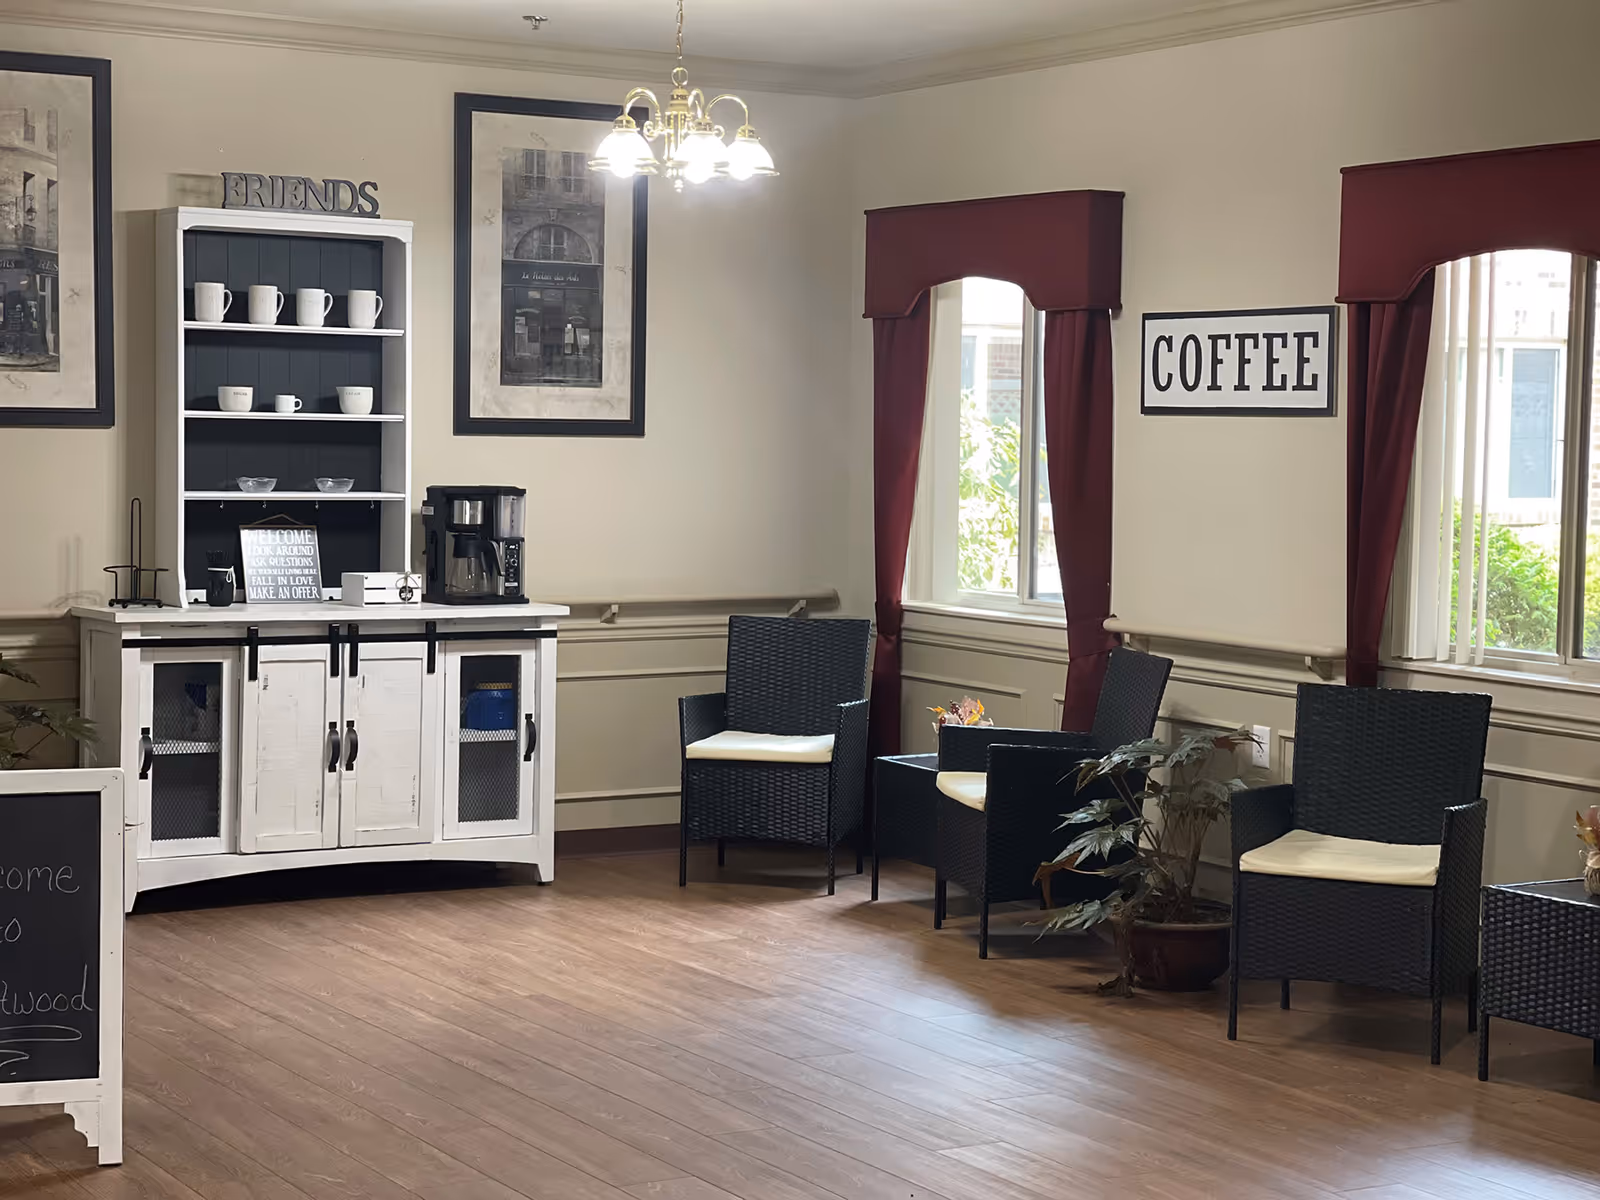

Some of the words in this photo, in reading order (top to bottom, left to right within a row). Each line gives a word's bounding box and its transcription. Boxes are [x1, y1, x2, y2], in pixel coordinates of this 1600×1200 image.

[220, 172, 379, 214] FRIENDS
[1151, 331, 1319, 392] COFFEE
[245, 529, 315, 545] WELCOME
[276, 545, 314, 556] AROUND
[249, 557, 267, 567] ASK
[269, 557, 314, 567] QUESTIONS
[251, 576, 275, 586] FALL
[277, 576, 287, 586] IN
[290, 576, 315, 586] LOVE
[249, 586, 276, 599] MAKE
[278, 586, 290, 599] AN
[292, 586, 320, 599] OFFER
[0, 865, 80, 894] ome
